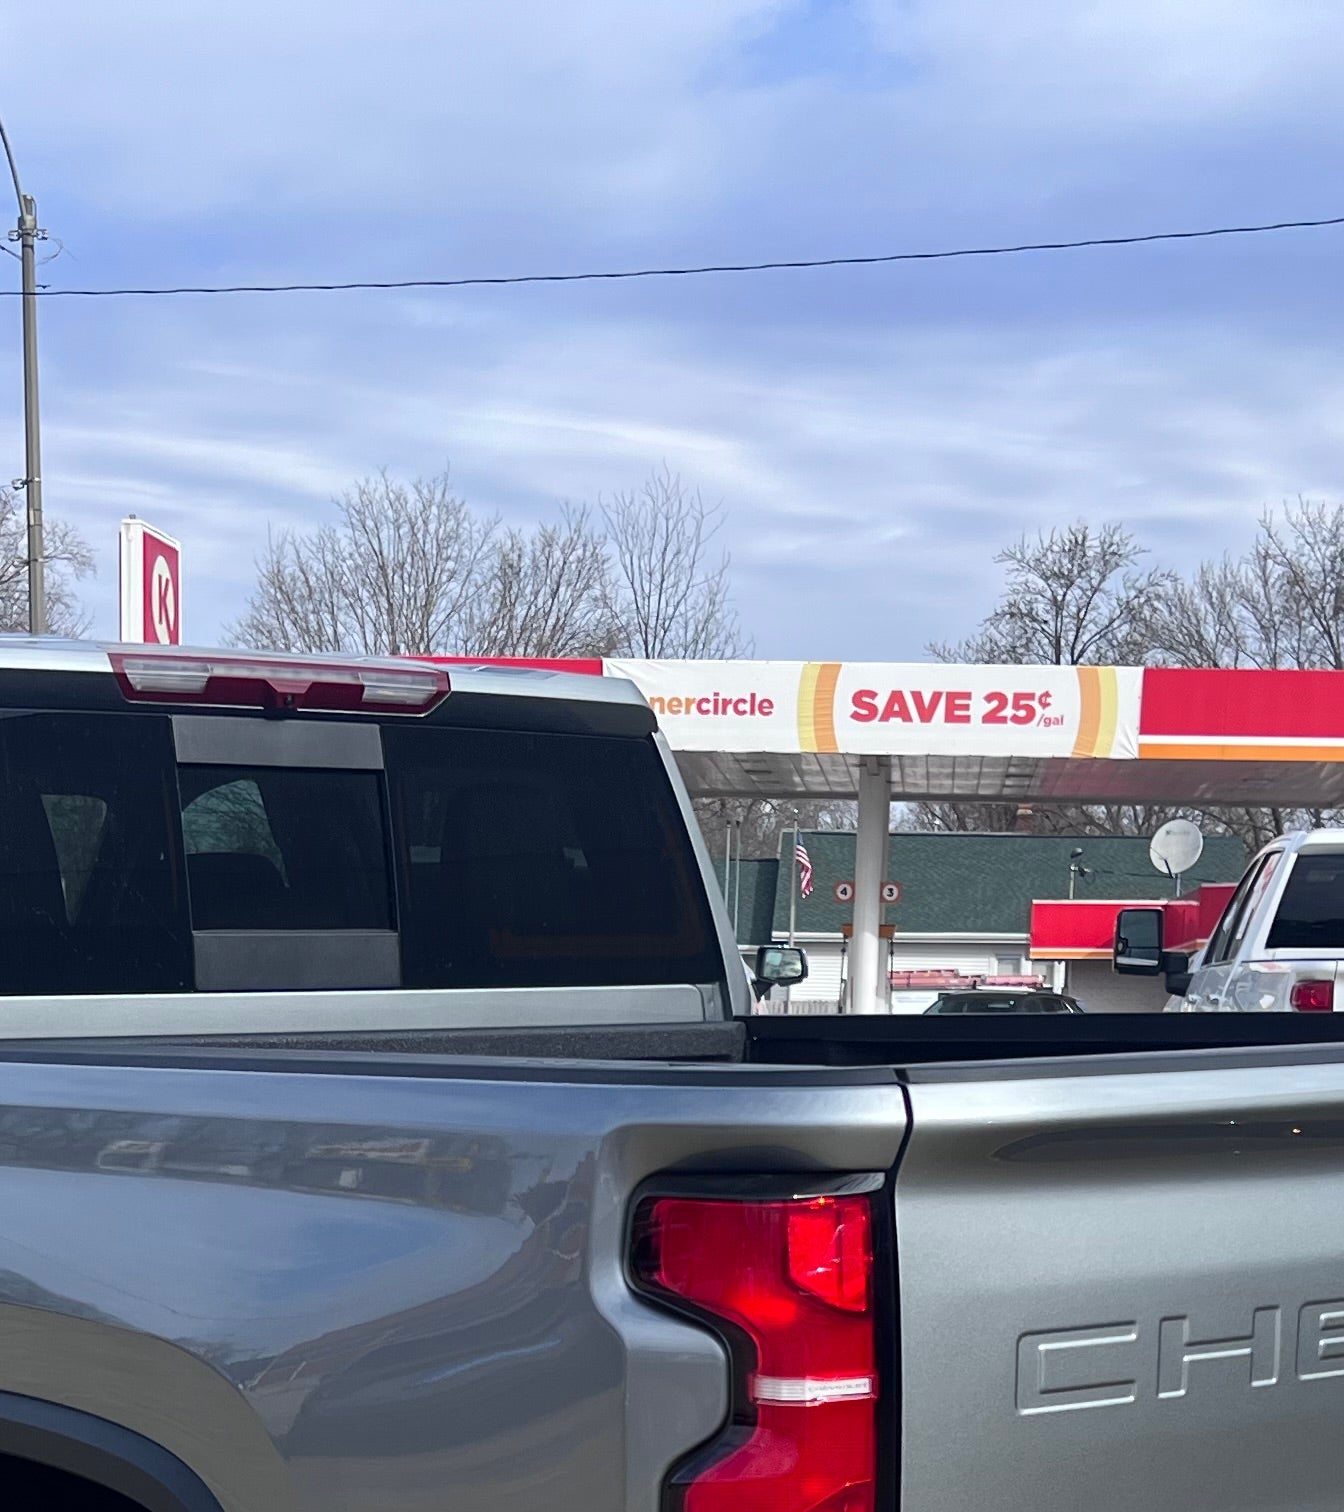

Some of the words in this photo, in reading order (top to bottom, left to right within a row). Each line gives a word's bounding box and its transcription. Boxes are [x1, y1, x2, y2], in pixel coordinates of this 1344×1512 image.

[849, 689, 973, 724] SAVE
[840, 886, 848, 897] 4
[886, 887, 895, 898] 3
